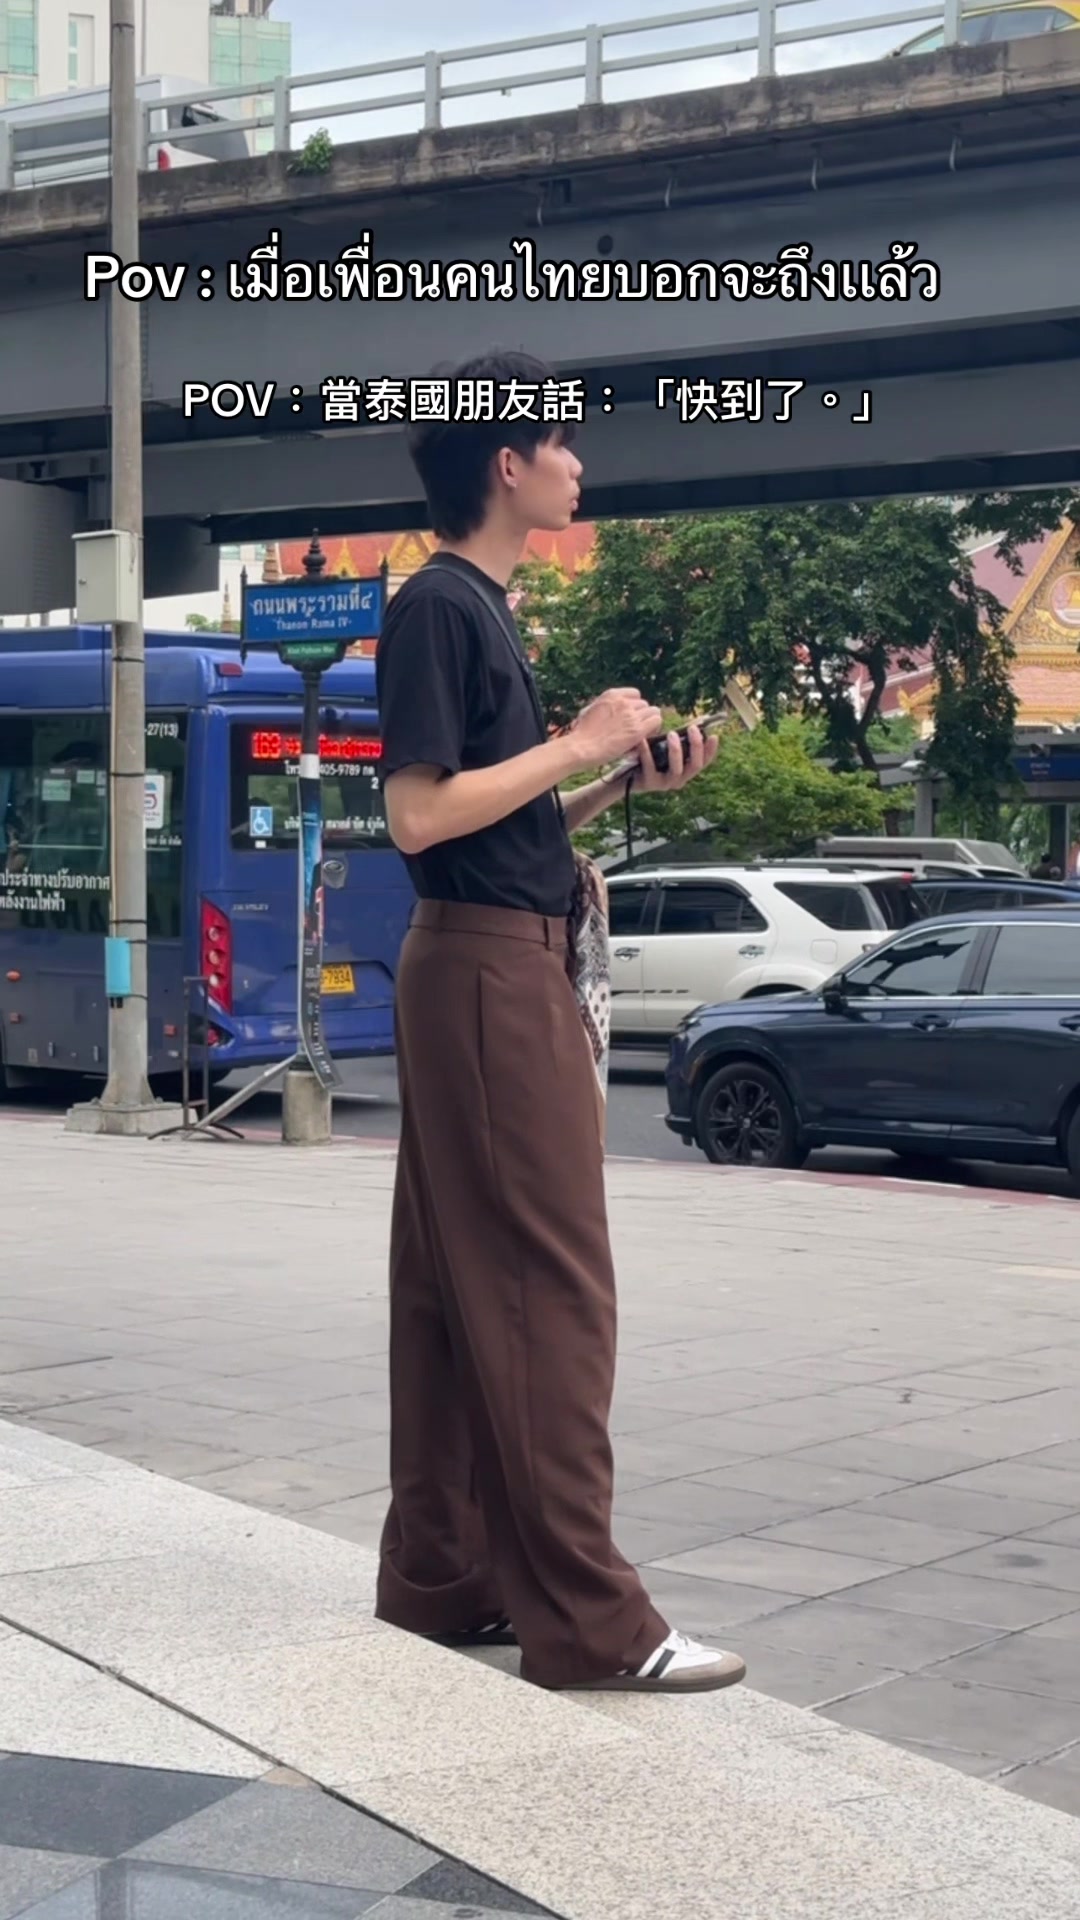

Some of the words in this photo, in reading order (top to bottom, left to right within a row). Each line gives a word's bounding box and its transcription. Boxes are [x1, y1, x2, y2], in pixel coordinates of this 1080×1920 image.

[276, 618, 308, 630] Thanon
[311, 617, 335, 629] Rama
[370, 777, 379, 790] 2
